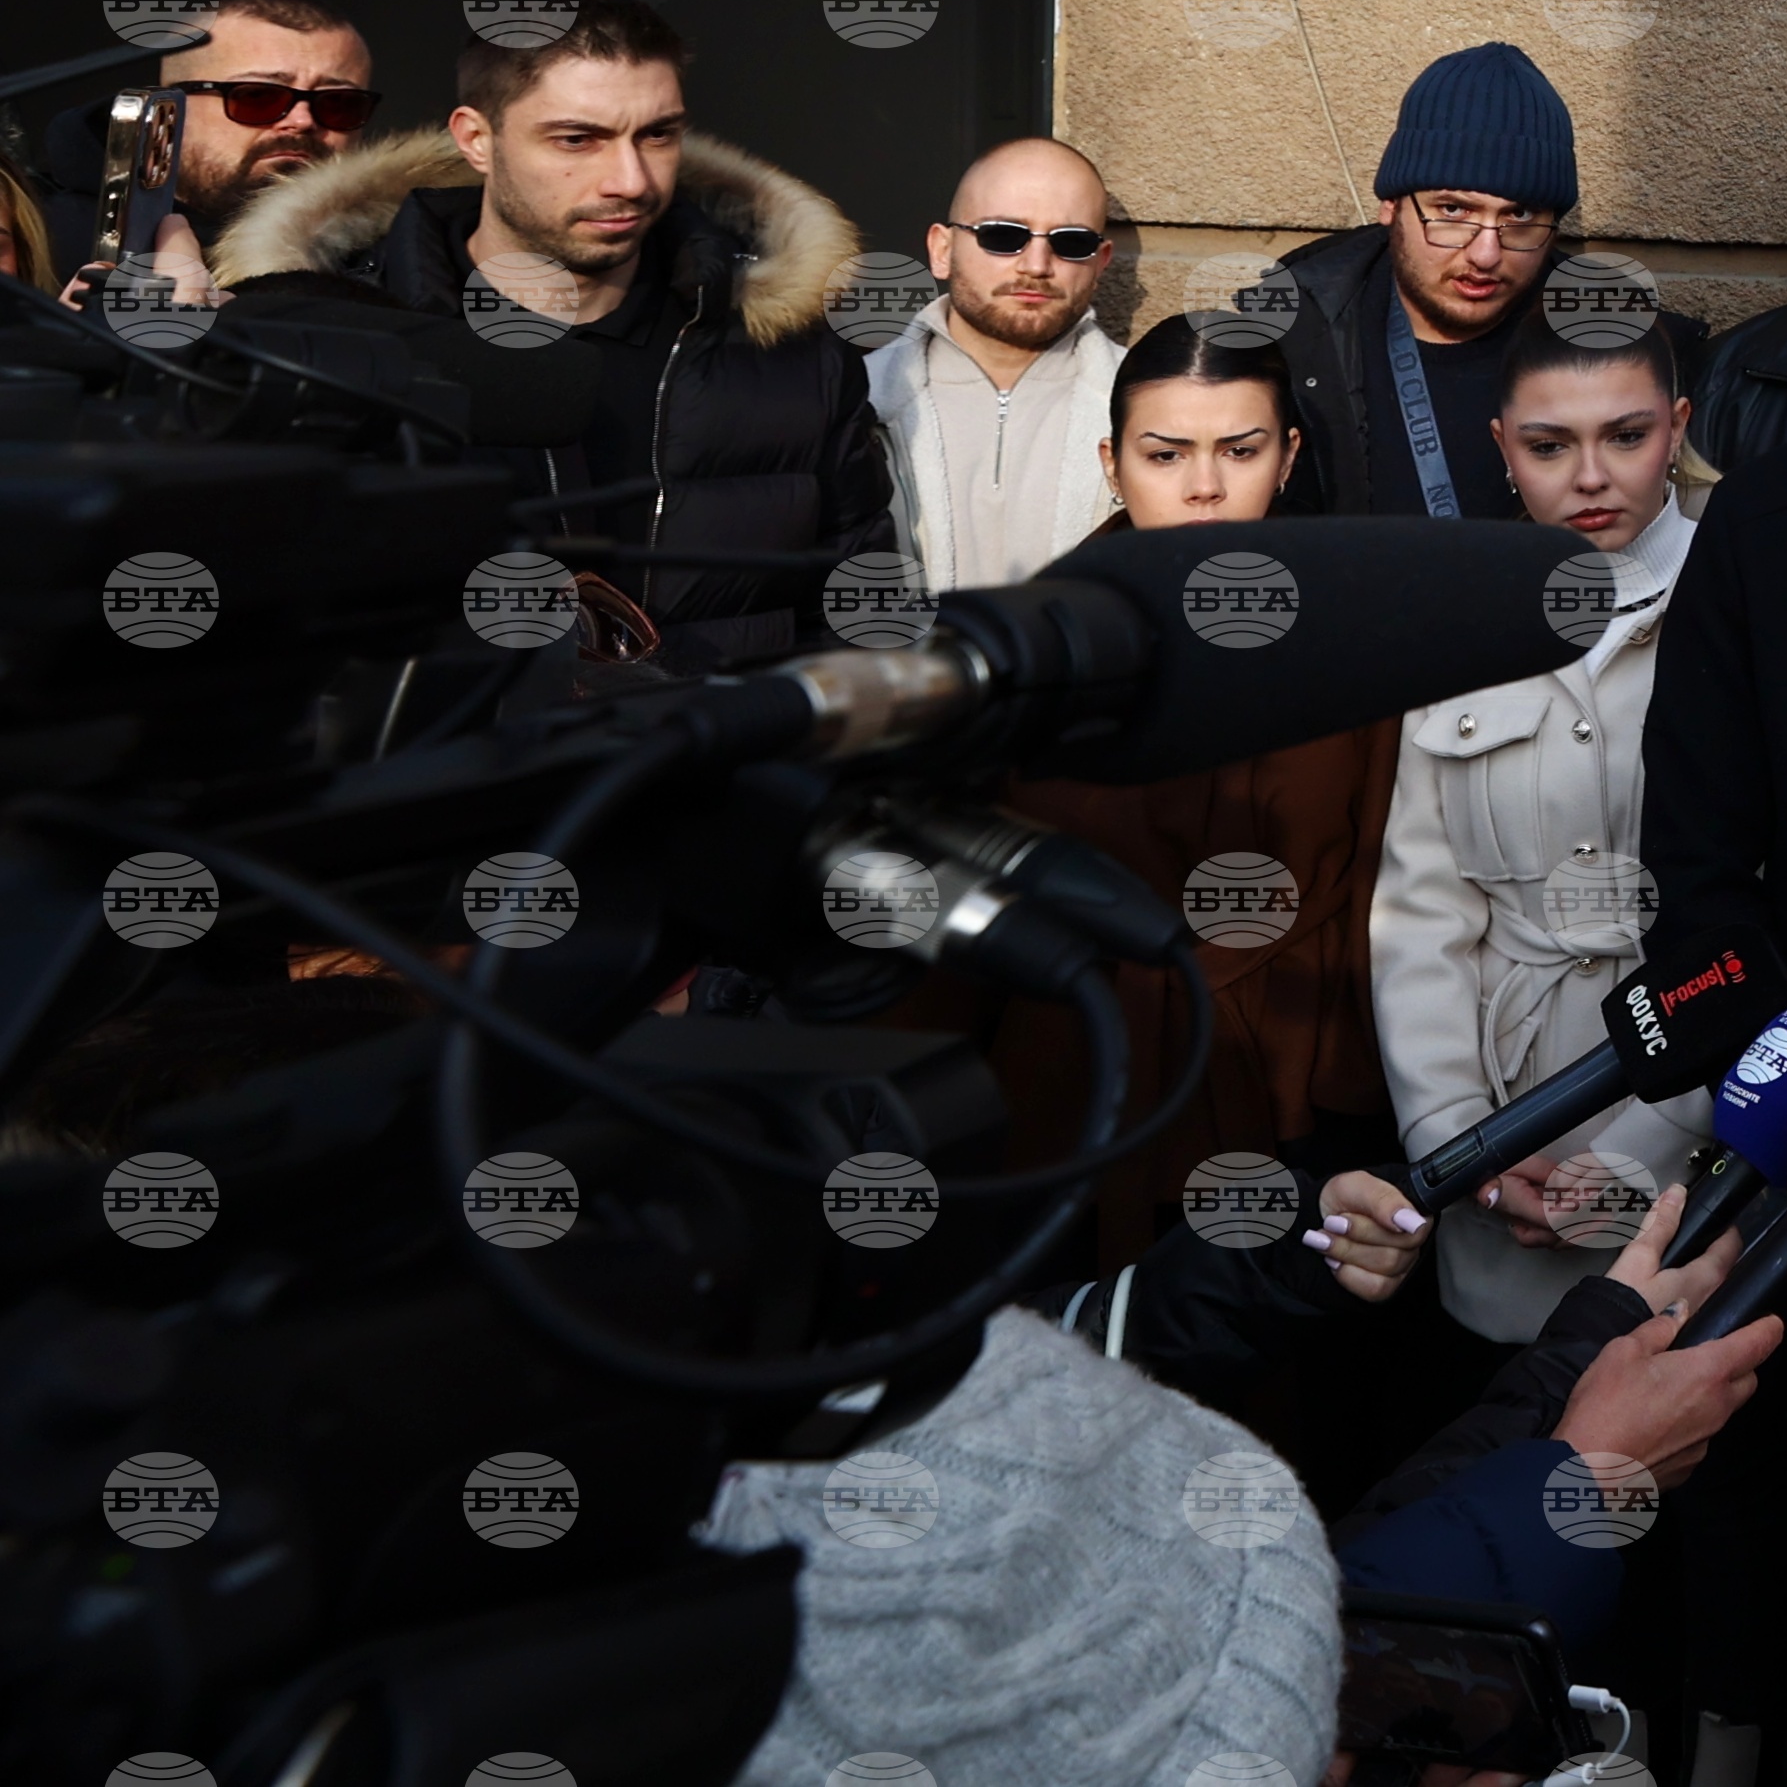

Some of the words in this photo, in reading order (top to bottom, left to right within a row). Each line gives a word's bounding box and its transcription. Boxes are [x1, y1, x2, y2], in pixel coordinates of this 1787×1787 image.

[1400, 378, 1439, 458] CLUB
[1626, 984, 1668, 1056] ФОКУС
[1666, 969, 1719, 1008] FOCUS
